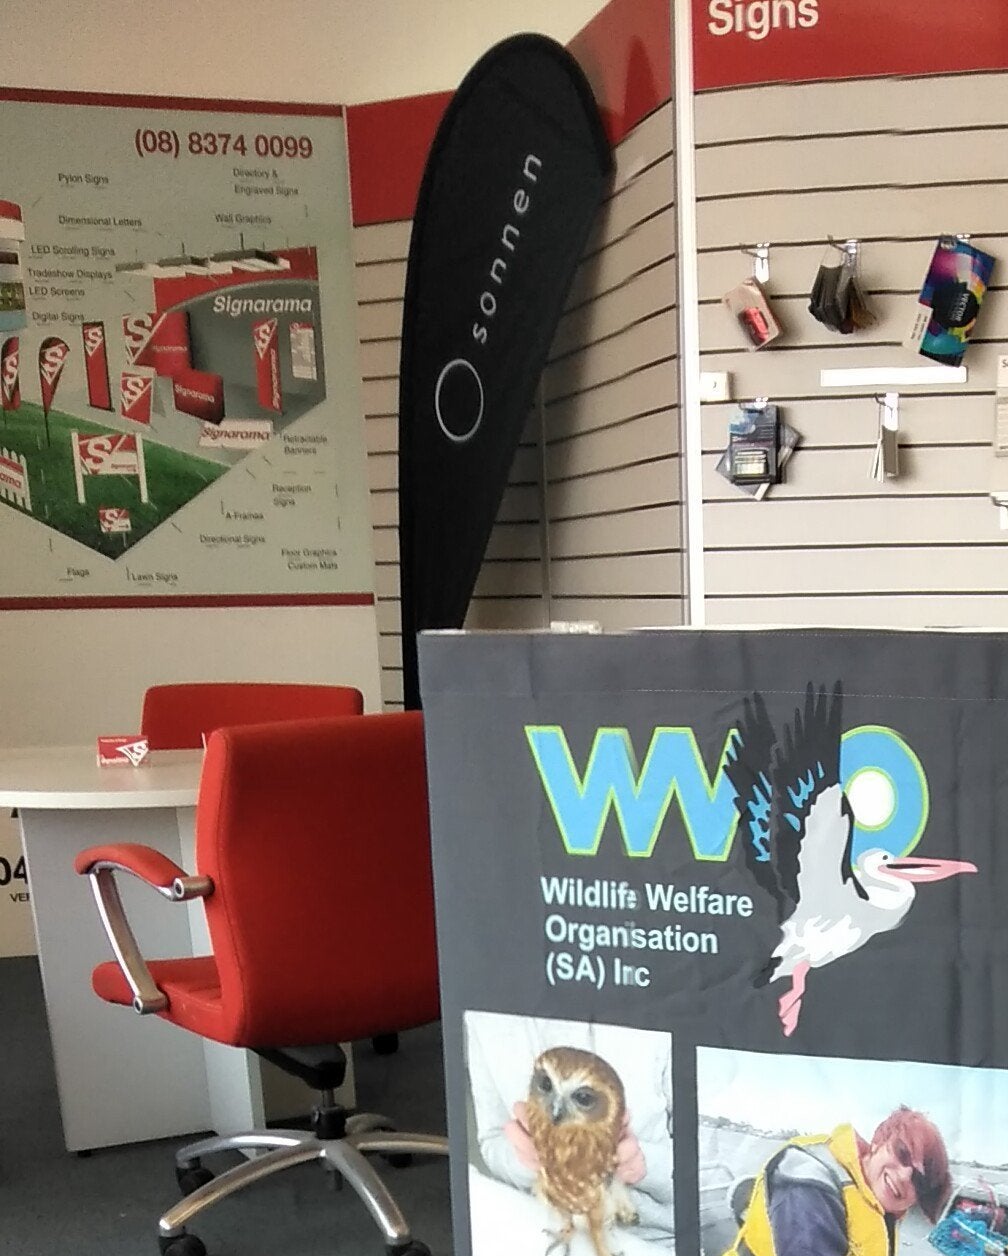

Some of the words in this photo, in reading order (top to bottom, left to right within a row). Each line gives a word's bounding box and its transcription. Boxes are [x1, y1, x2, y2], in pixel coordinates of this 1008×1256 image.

[708, 0, 819, 40] Signs
[135, 128, 180, 158] (08)
[188, 131, 247, 156] 8374
[254, 134, 313, 159] 0099
[58, 173, 83, 184] Pylon
[85, 173, 109, 185] Signs
[233, 168, 270, 179] Directory
[234, 184, 274, 196] Engraved
[276, 185, 299, 196] Signs
[58, 215, 111, 226] Dimensional
[113, 216, 142, 227] Letters
[215, 213, 233, 223] Wall
[235, 213, 272, 224] Graphics
[31, 245, 50, 254] LED
[473, 153, 542, 344] sonnen
[28, 268, 74, 278] Tradeshow
[76, 269, 113, 279] Displays
[29, 286, 48, 295] LED
[50, 286, 85, 296] Screens
[213, 295, 312, 316] Signarama
[32, 311, 59, 321] Digital
[61, 312, 85, 322] Signs
[201, 427, 270, 441] Signarama
[272, 483, 311, 493] Reception
[200, 534, 241, 544] Directional
[67, 567, 90, 577] Flags
[132, 572, 154, 582] Lawn
[540, 876, 638, 910] Wildlife
[645, 882, 754, 917] Welfare
[545, 913, 719, 954] Organisation
[546, 950, 606, 990] (SA)
[614, 957, 650, 987] Inc
